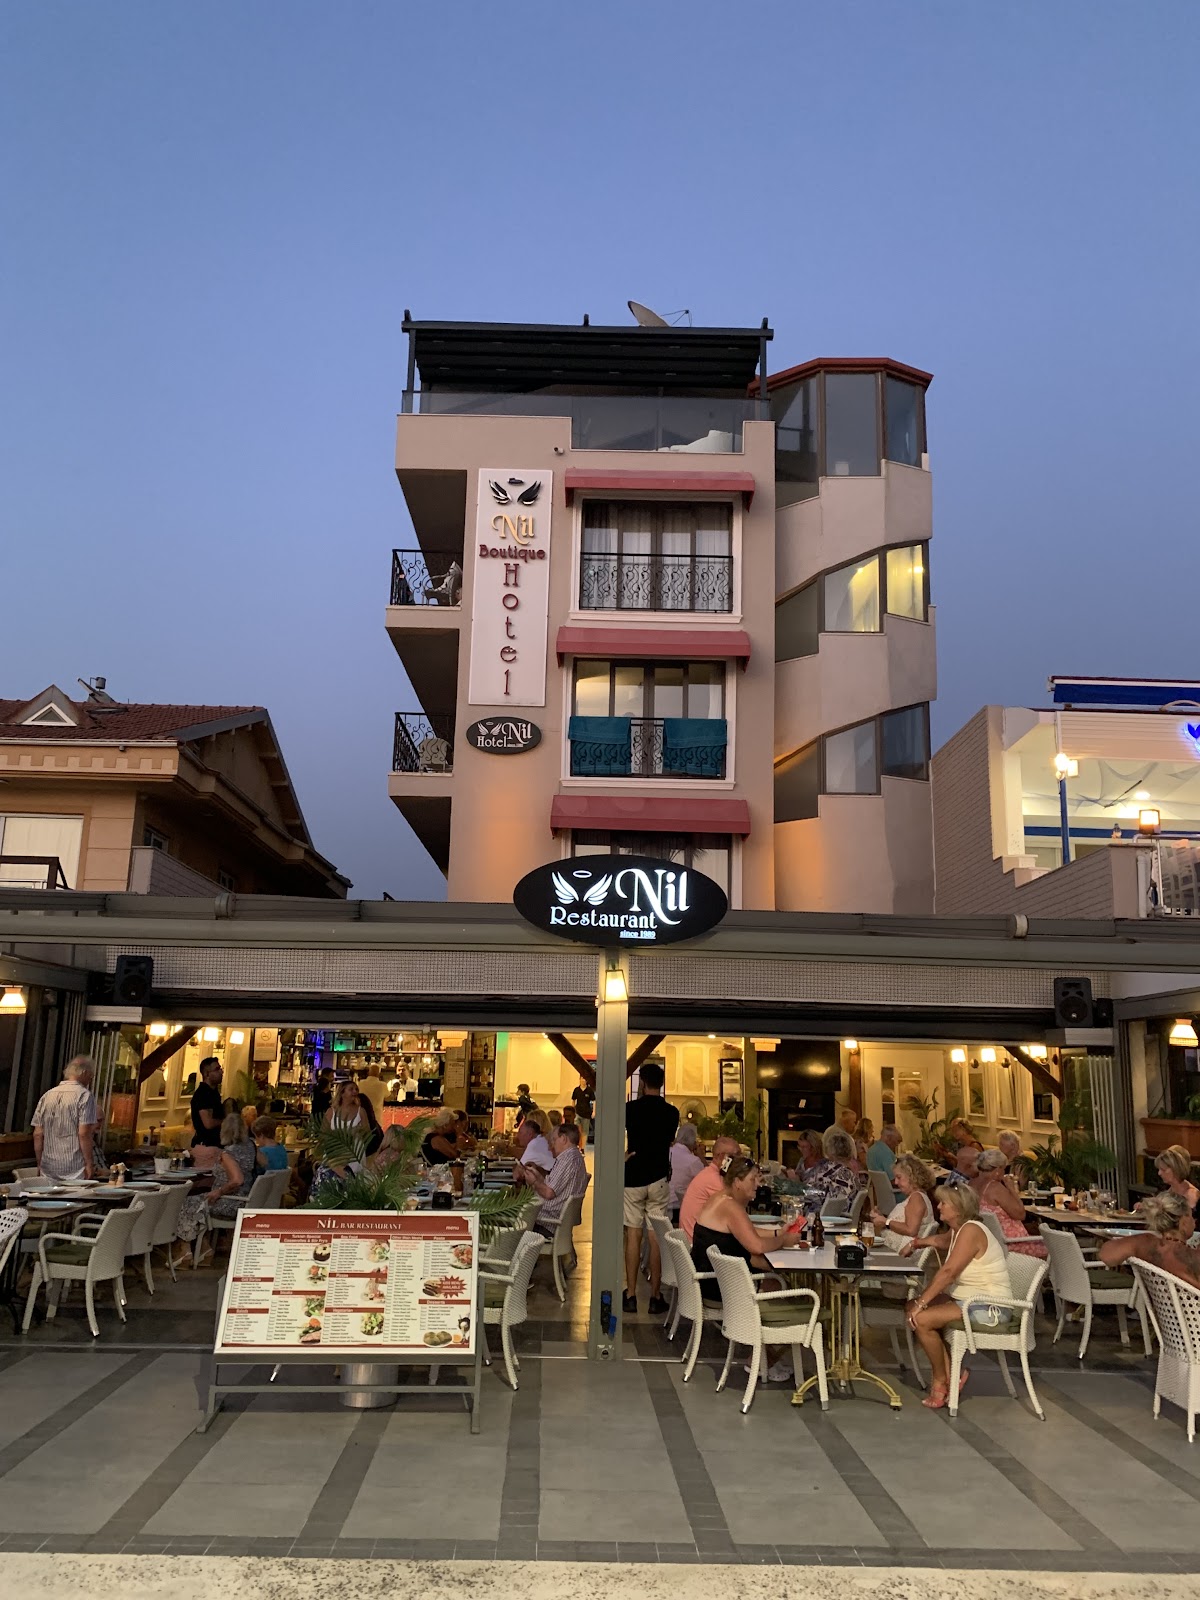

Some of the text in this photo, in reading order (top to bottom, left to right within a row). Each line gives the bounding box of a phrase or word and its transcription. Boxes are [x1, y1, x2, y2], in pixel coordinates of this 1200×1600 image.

[491, 514, 534, 545] Nil
[479, 544, 546, 563] Boutique
[500, 563, 519, 695] Hotel
[477, 735, 507, 748] Hotel
[501, 722, 533, 744] Nil
[615, 868, 690, 925] Nil
[550, 906, 657, 929] Restaurant
[620, 930, 639, 938] since
